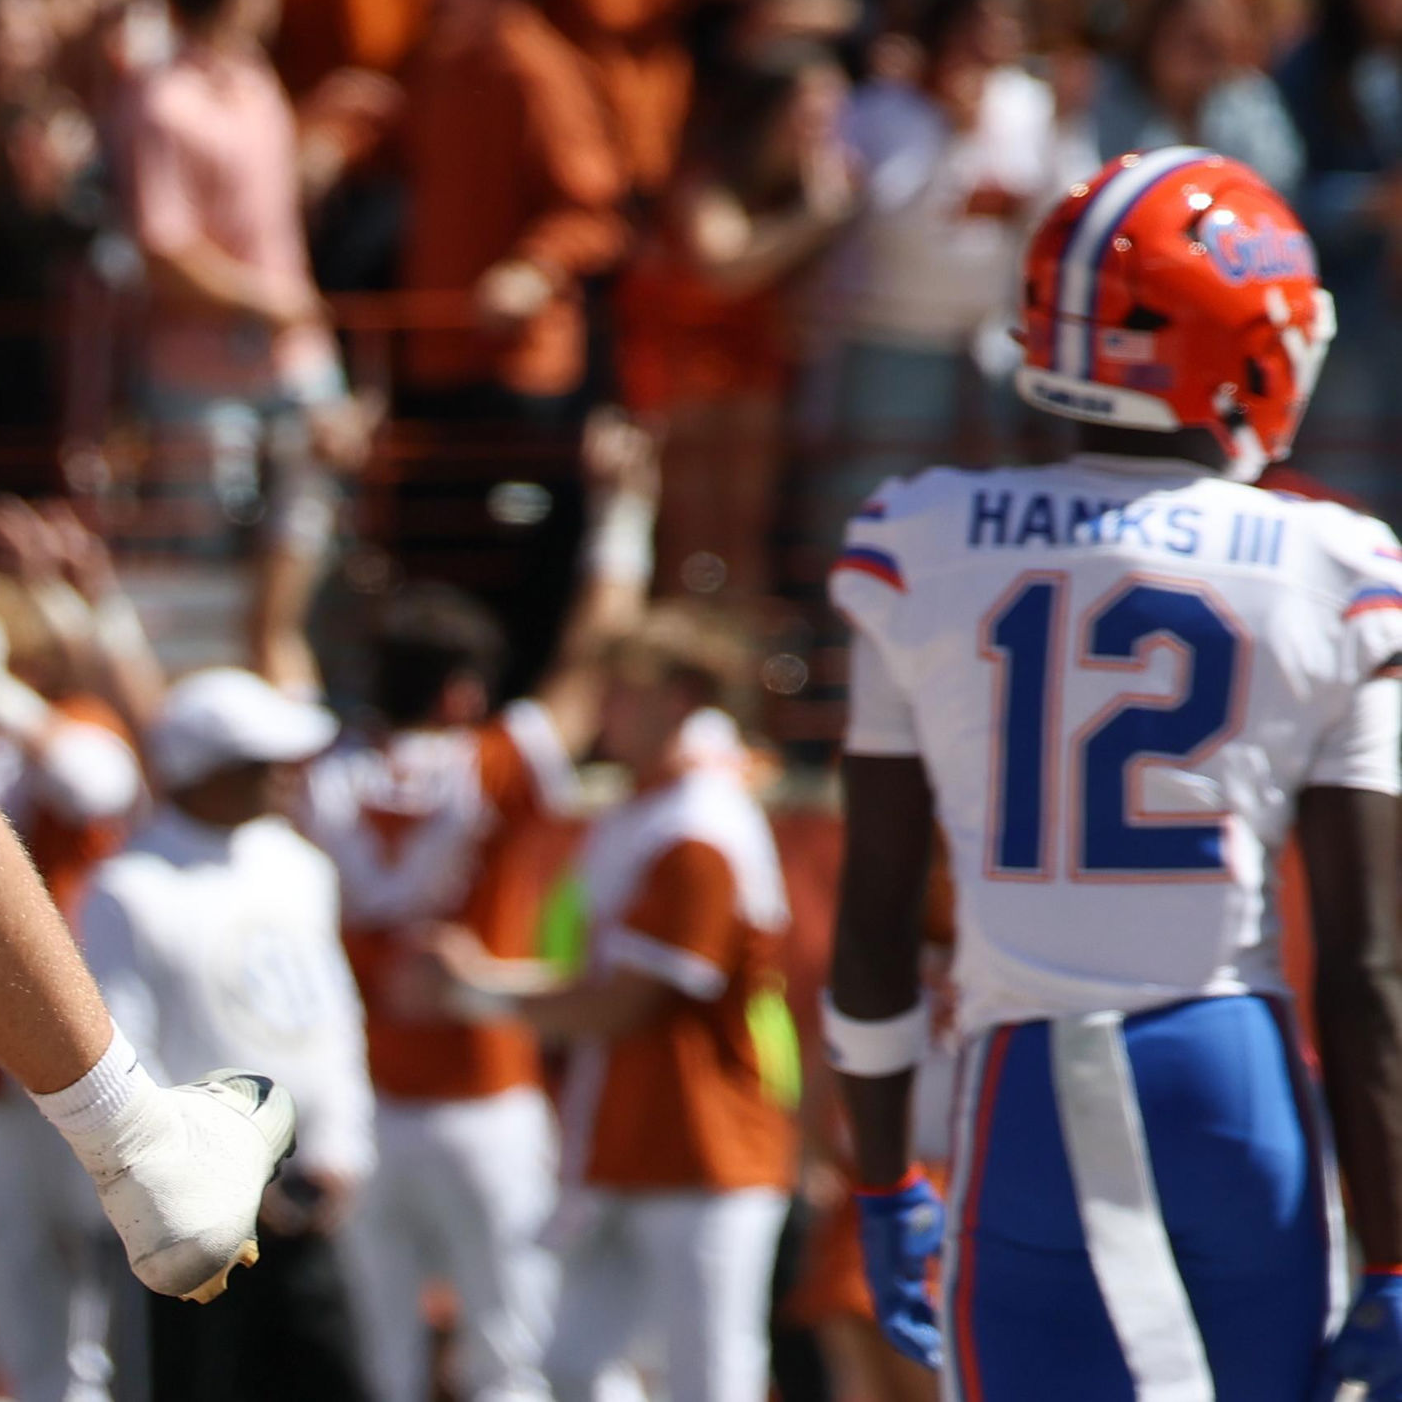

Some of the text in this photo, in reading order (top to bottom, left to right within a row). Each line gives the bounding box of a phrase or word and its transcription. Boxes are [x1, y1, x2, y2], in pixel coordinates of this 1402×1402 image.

[967, 489, 1285, 567] HANKS III
[978, 569, 1253, 884] 12
